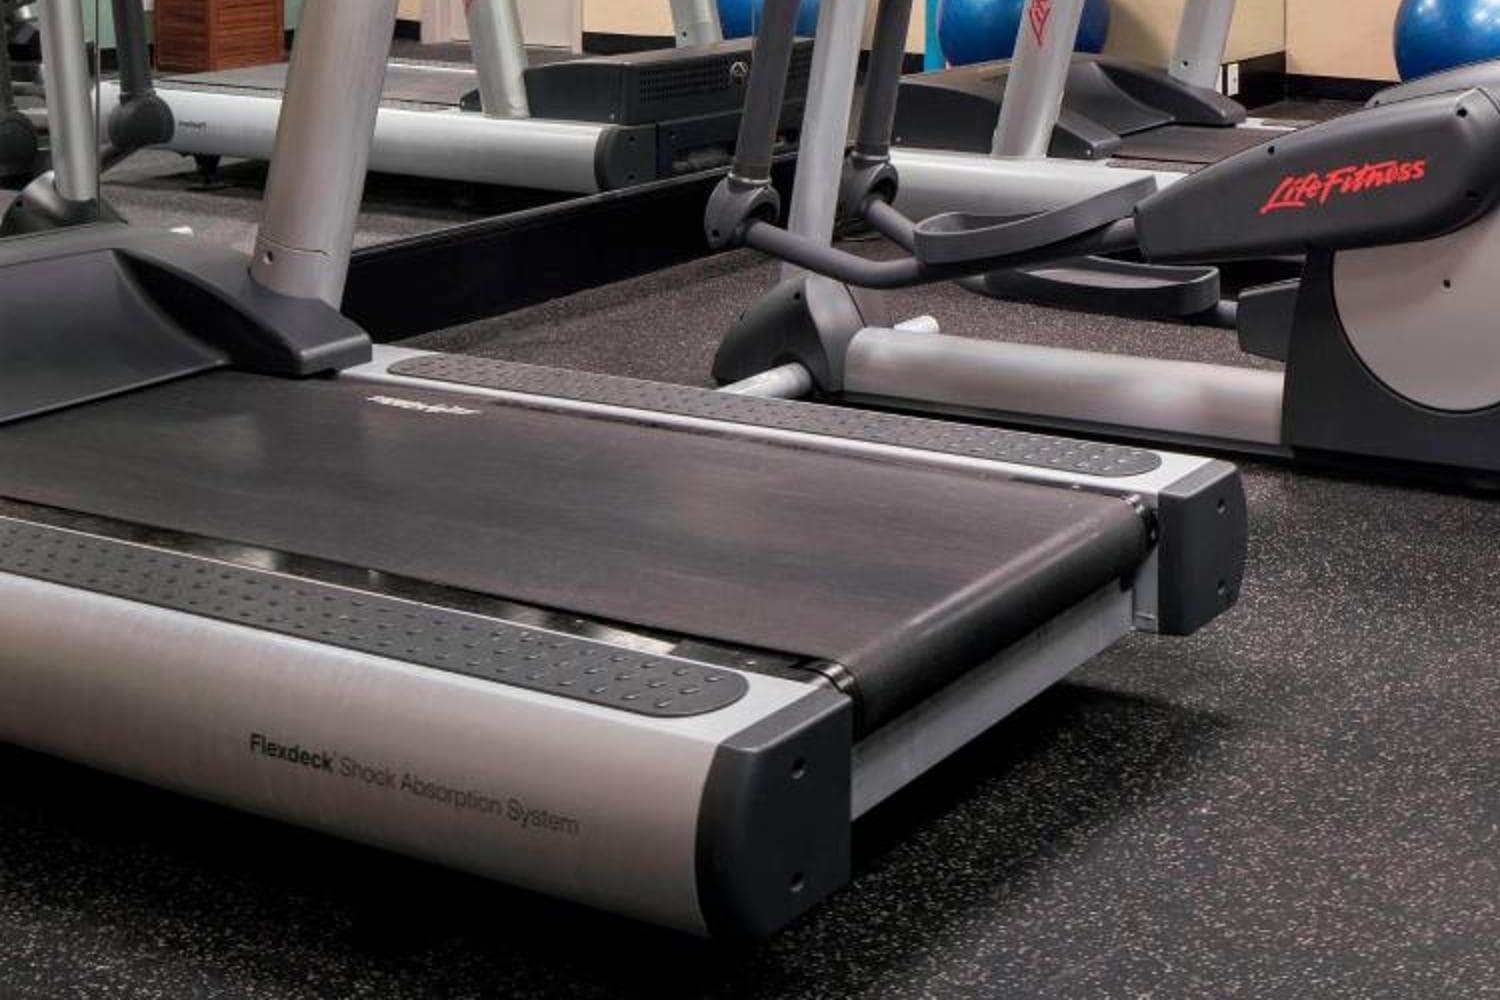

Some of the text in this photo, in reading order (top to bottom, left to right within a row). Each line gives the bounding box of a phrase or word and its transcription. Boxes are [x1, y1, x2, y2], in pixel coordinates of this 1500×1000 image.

[250, 733, 580, 837] Flexdeck Shock Absorption System
